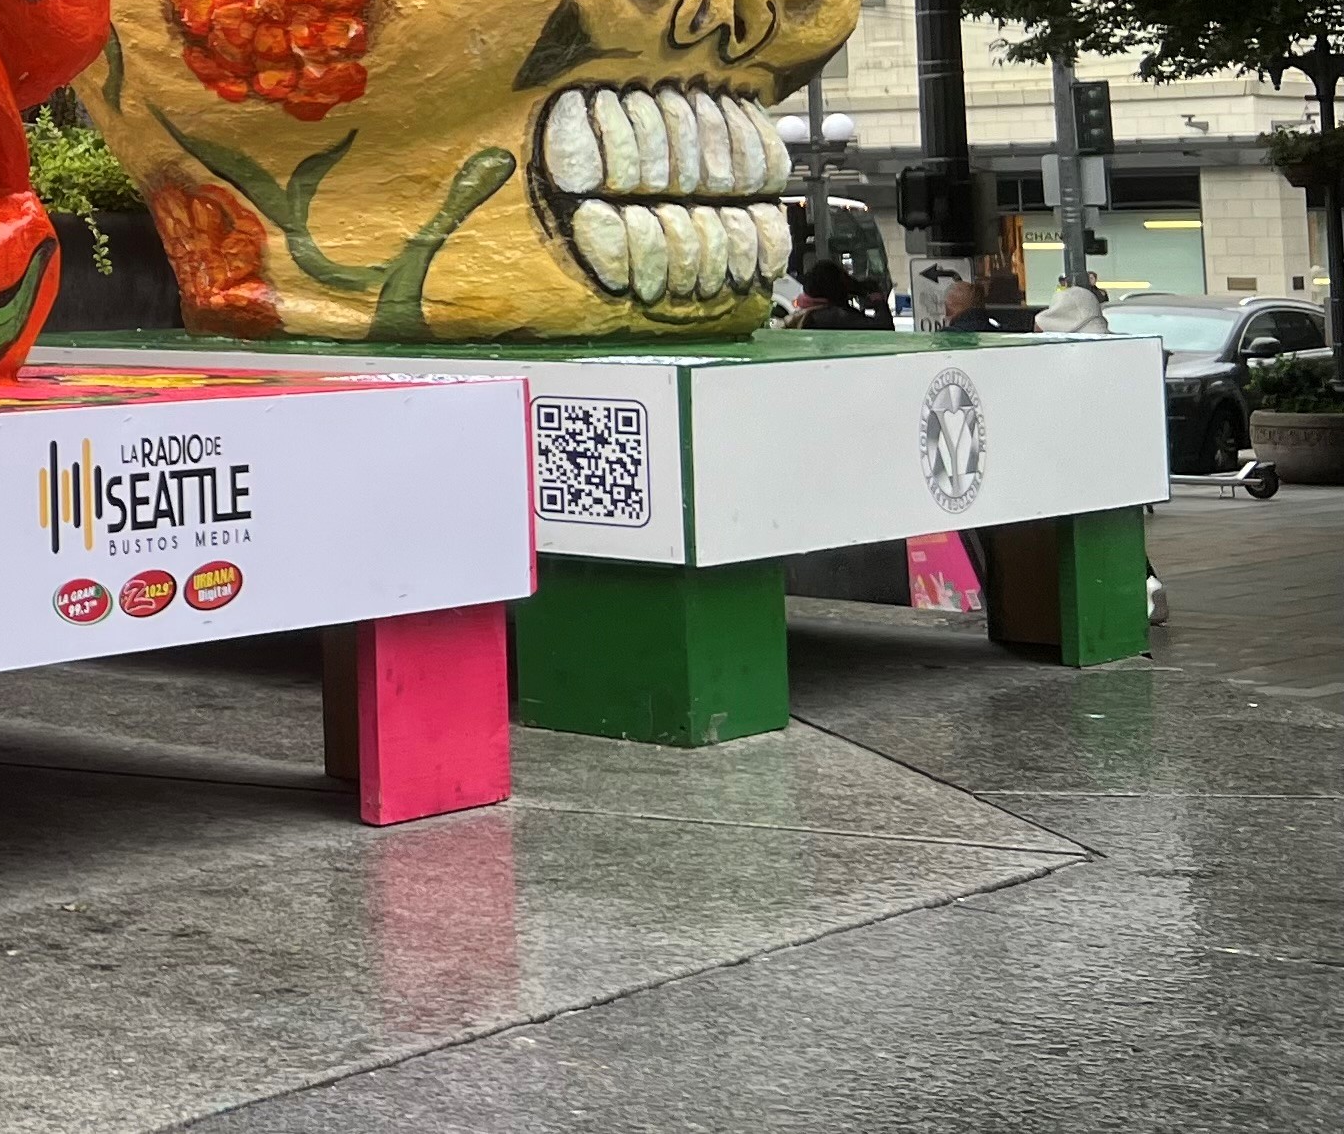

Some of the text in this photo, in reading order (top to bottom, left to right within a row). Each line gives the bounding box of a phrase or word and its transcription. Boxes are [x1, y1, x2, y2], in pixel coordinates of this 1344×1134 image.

[120, 434, 222, 468] LA RADIO DE
[105, 465, 252, 534] SEATTLE
[109, 528, 252, 556] BUSTOS MEDIA
